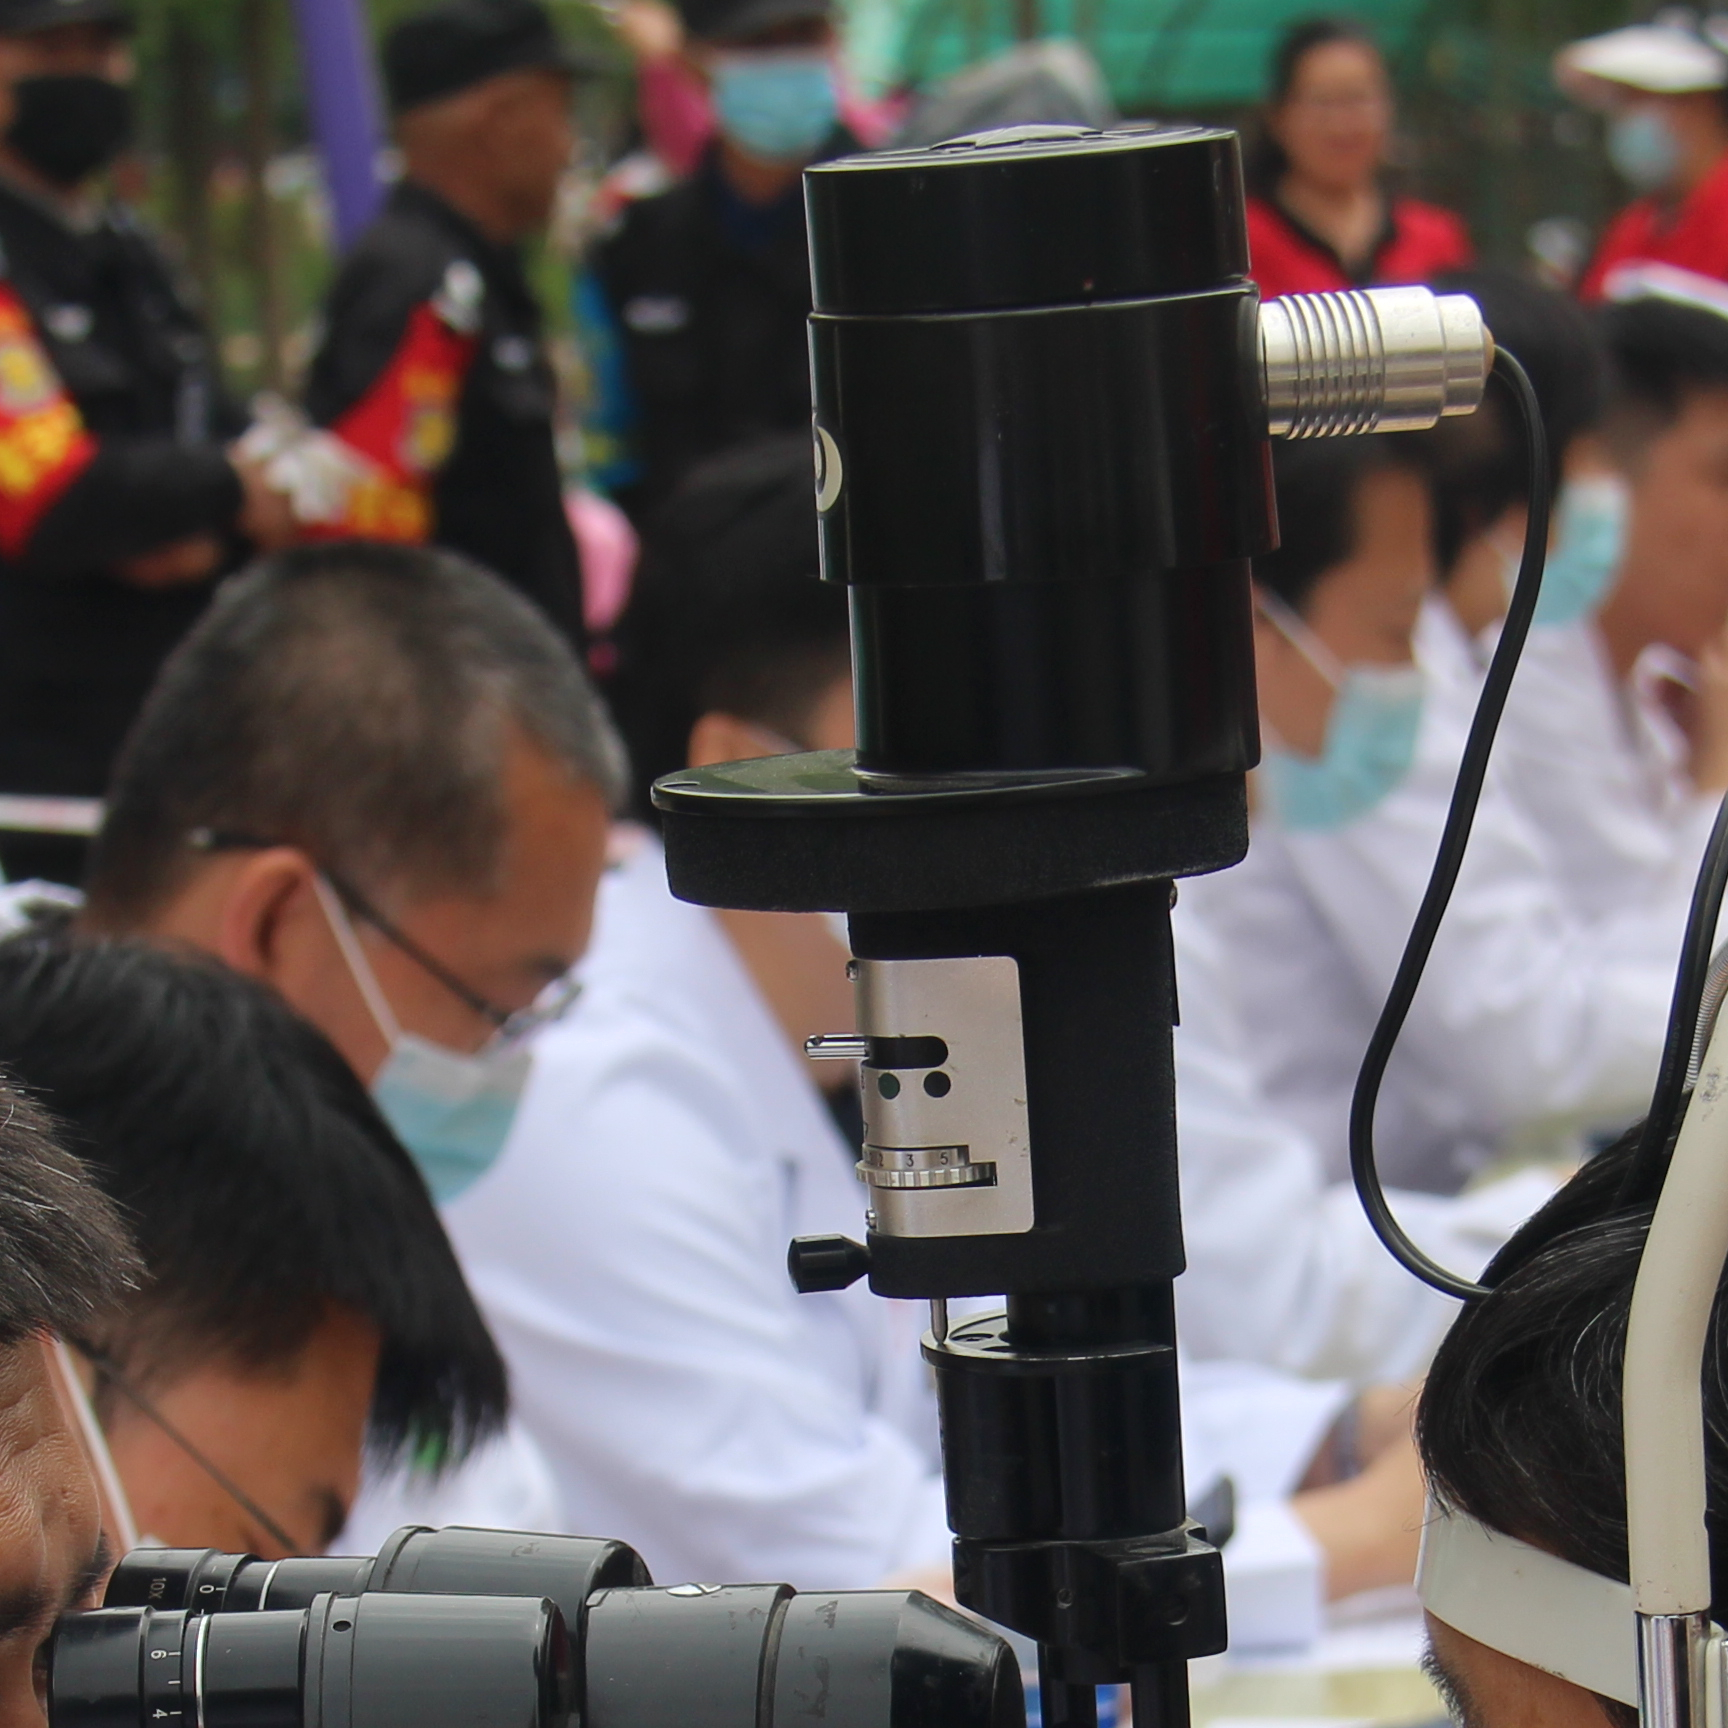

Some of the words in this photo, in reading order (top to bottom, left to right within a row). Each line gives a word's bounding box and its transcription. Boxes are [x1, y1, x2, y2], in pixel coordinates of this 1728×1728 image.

[905, 1153, 915, 1168] 3
[940, 1151, 949, 1165] 5
[199, 1584, 215, 1594] 0
[150, 1649, 167, 1660] 6
[152, 1708, 168, 1719] 4
